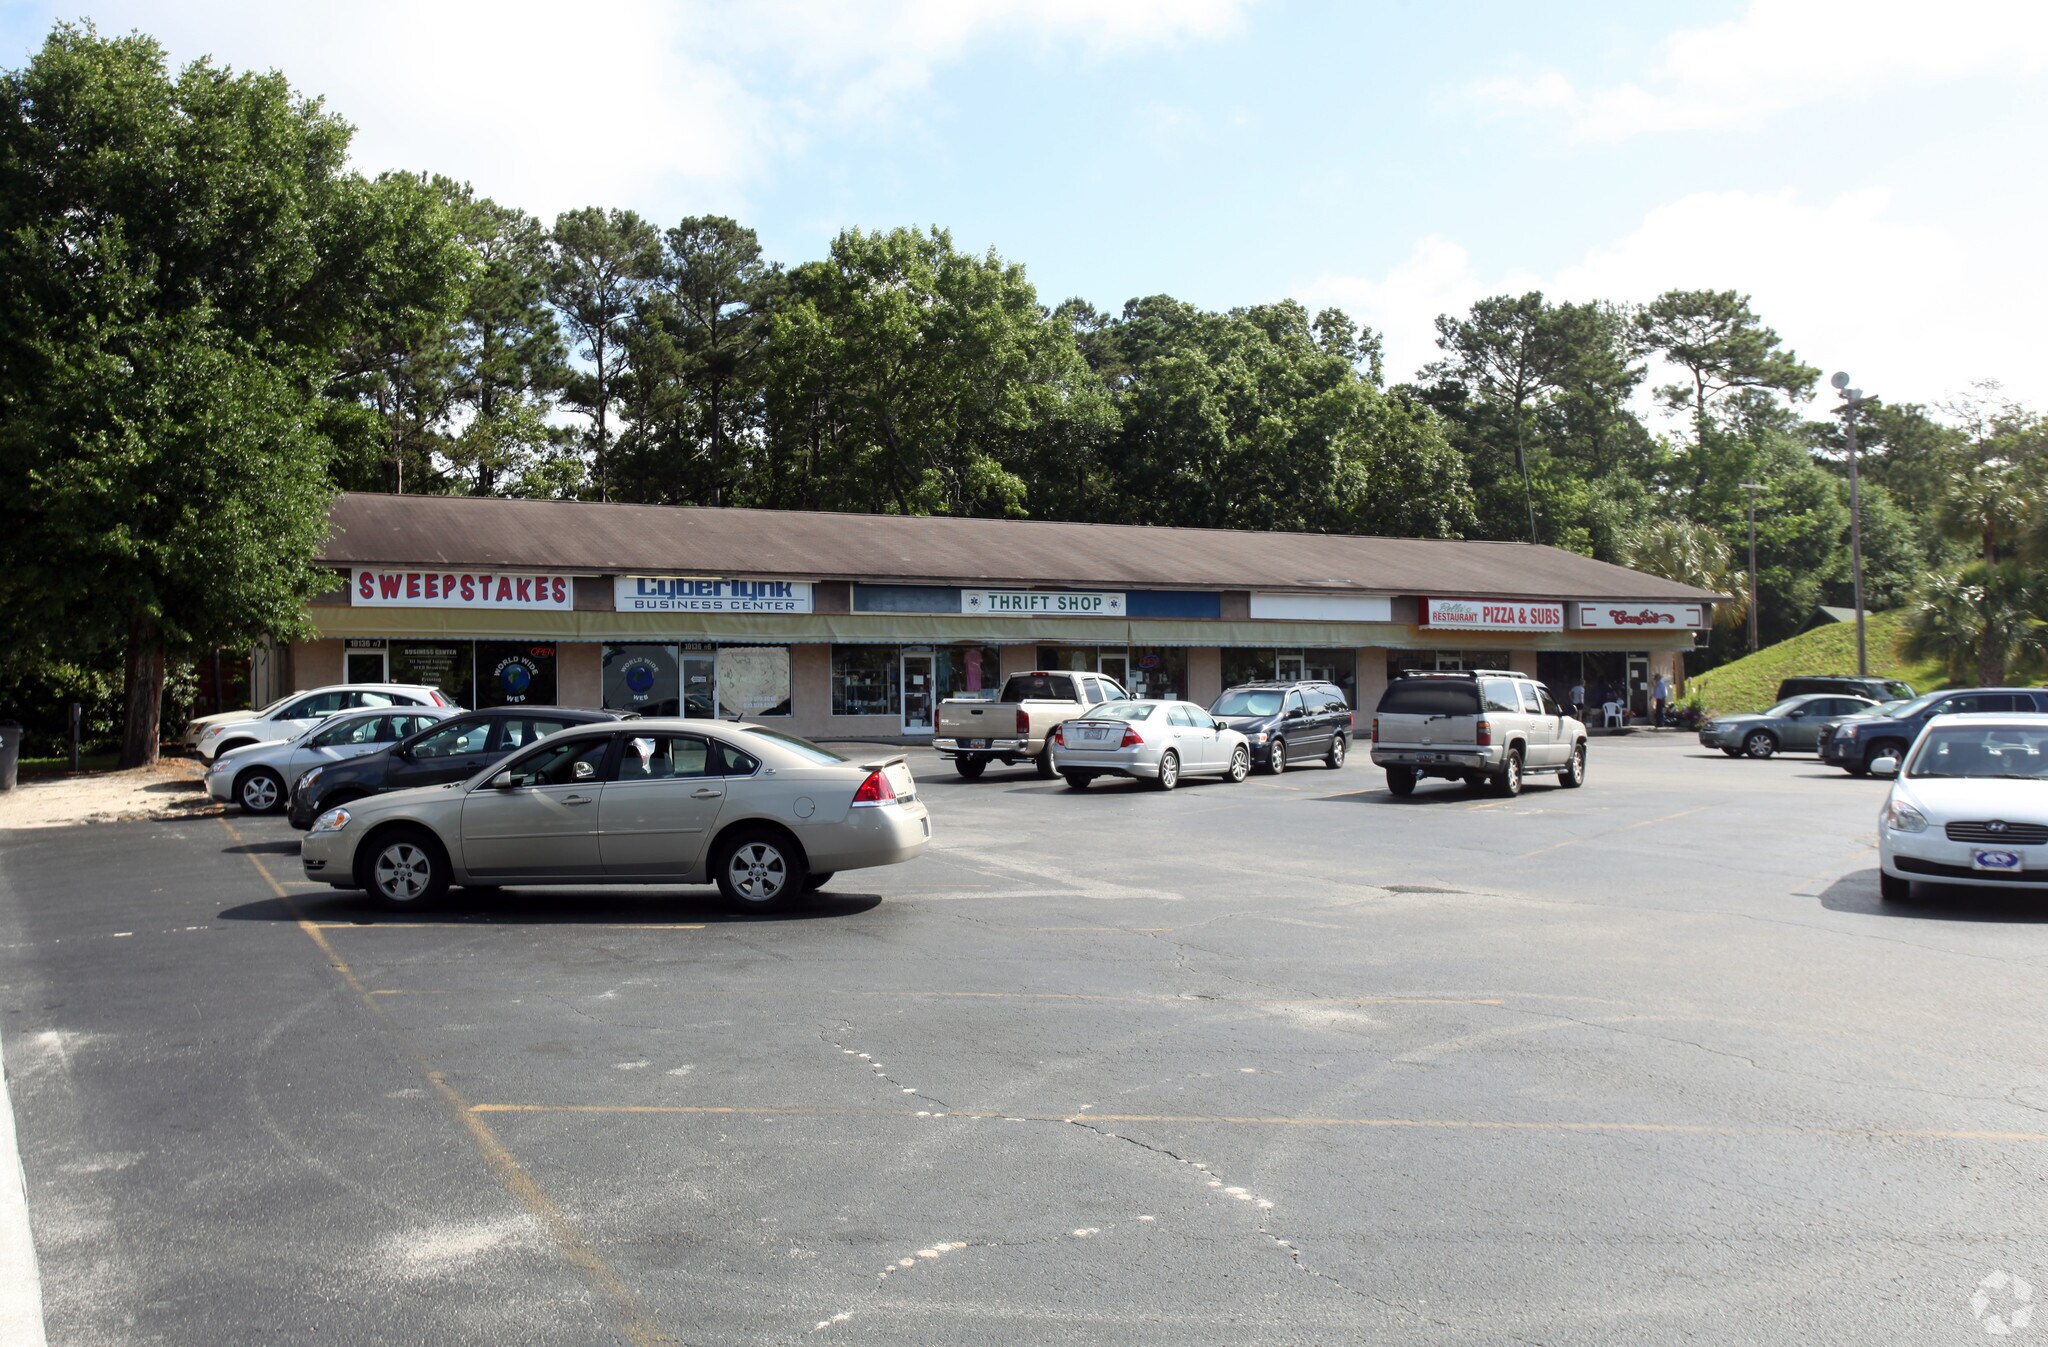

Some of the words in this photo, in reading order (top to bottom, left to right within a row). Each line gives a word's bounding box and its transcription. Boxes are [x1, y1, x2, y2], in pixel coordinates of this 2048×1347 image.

[359, 571, 566, 603] SWEEPSTAKES
[634, 600, 723, 610] BUSINESS
[730, 601, 795, 611] CENTER
[988, 595, 1049, 610] THRIFT
[1057, 596, 1102, 611] SHOP
[1432, 611, 1478, 623] RESTAURANT
[1482, 606, 1515, 624] PIZZA
[1518, 607, 1527, 624] &
[1530, 607, 1560, 625] SUBS
[530, 647, 556, 657] OPEN
[494, 656, 519, 677] WORLD
[521, 657, 539, 676] WIDE
[620, 657, 643, 673] WORLD
[644, 658, 660, 673] WIDE
[506, 694, 526, 703] WEB
